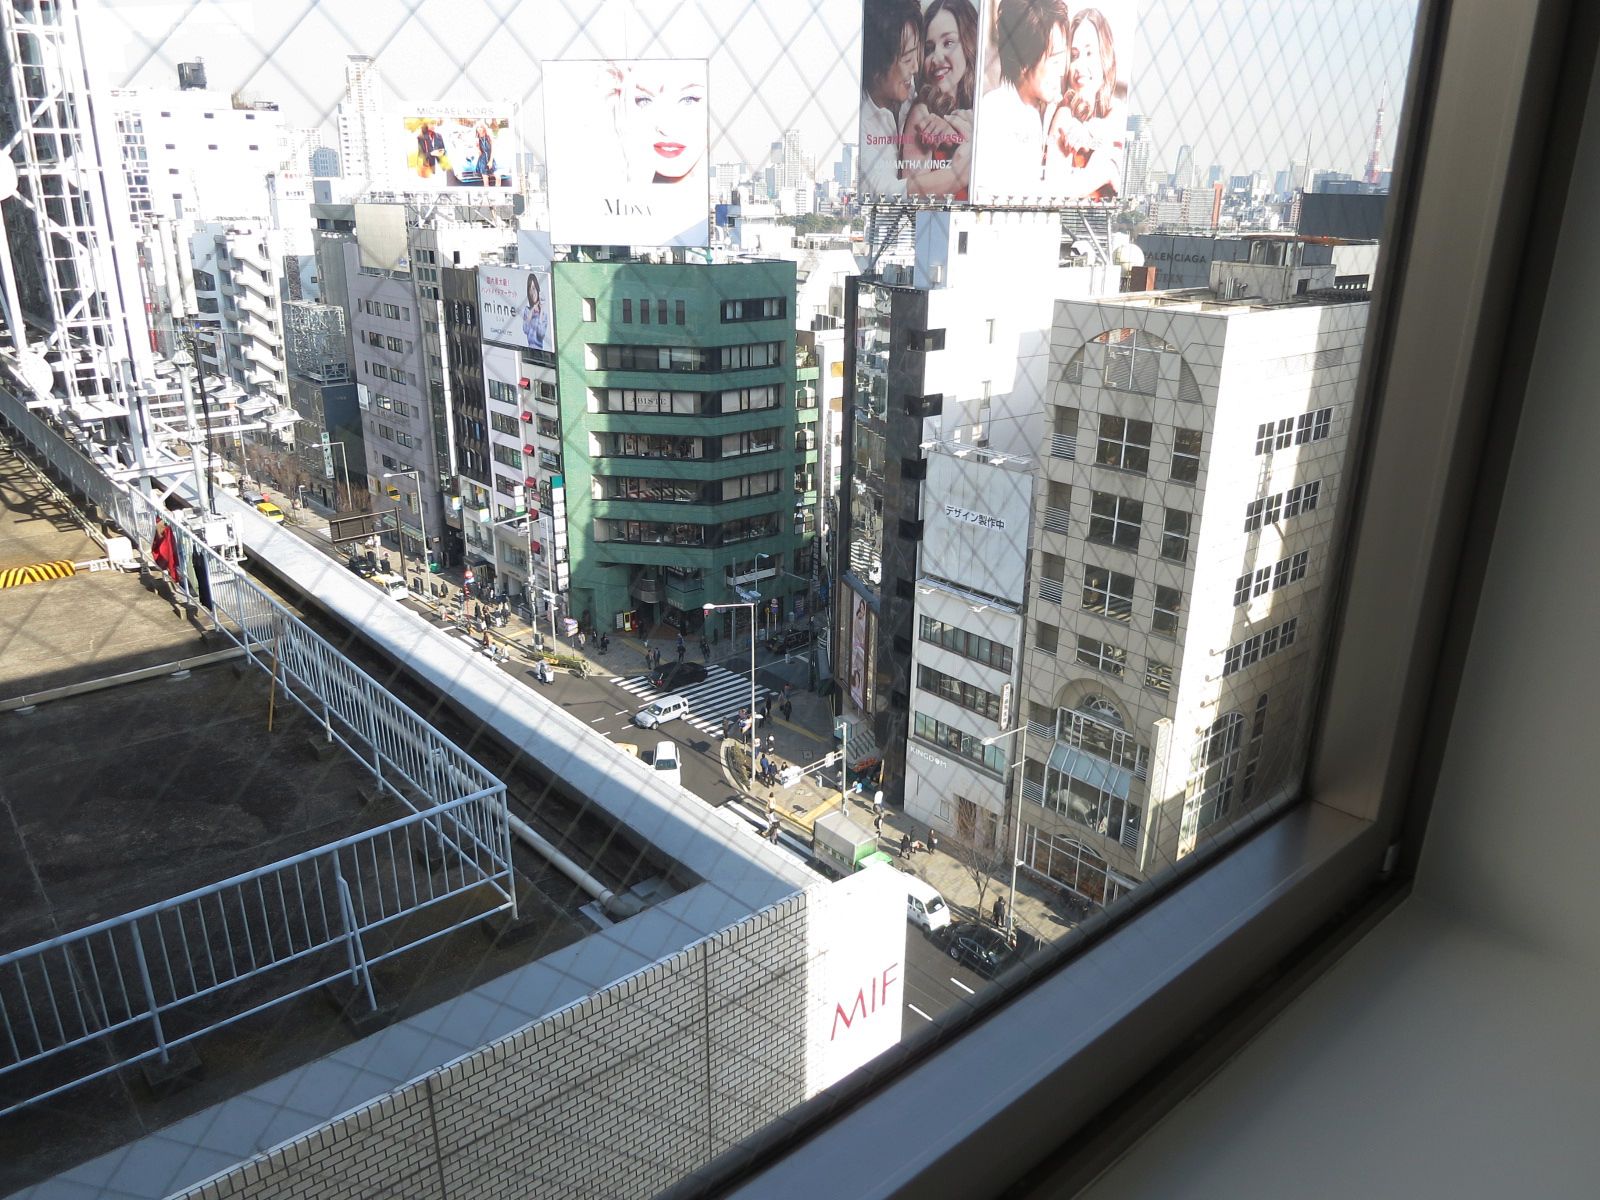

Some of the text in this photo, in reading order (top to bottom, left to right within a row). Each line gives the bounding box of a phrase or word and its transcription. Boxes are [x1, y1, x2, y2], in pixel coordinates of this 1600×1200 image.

[416, 106, 495, 115] MICHAEL KORS
[924, 159, 953, 170] KINGZ
[1144, 249, 1207, 264] ALENCIAGA
[484, 300, 517, 318] minne
[631, 397, 667, 406] ABISTE
[945, 505, 1005, 530] デザイン製作中
